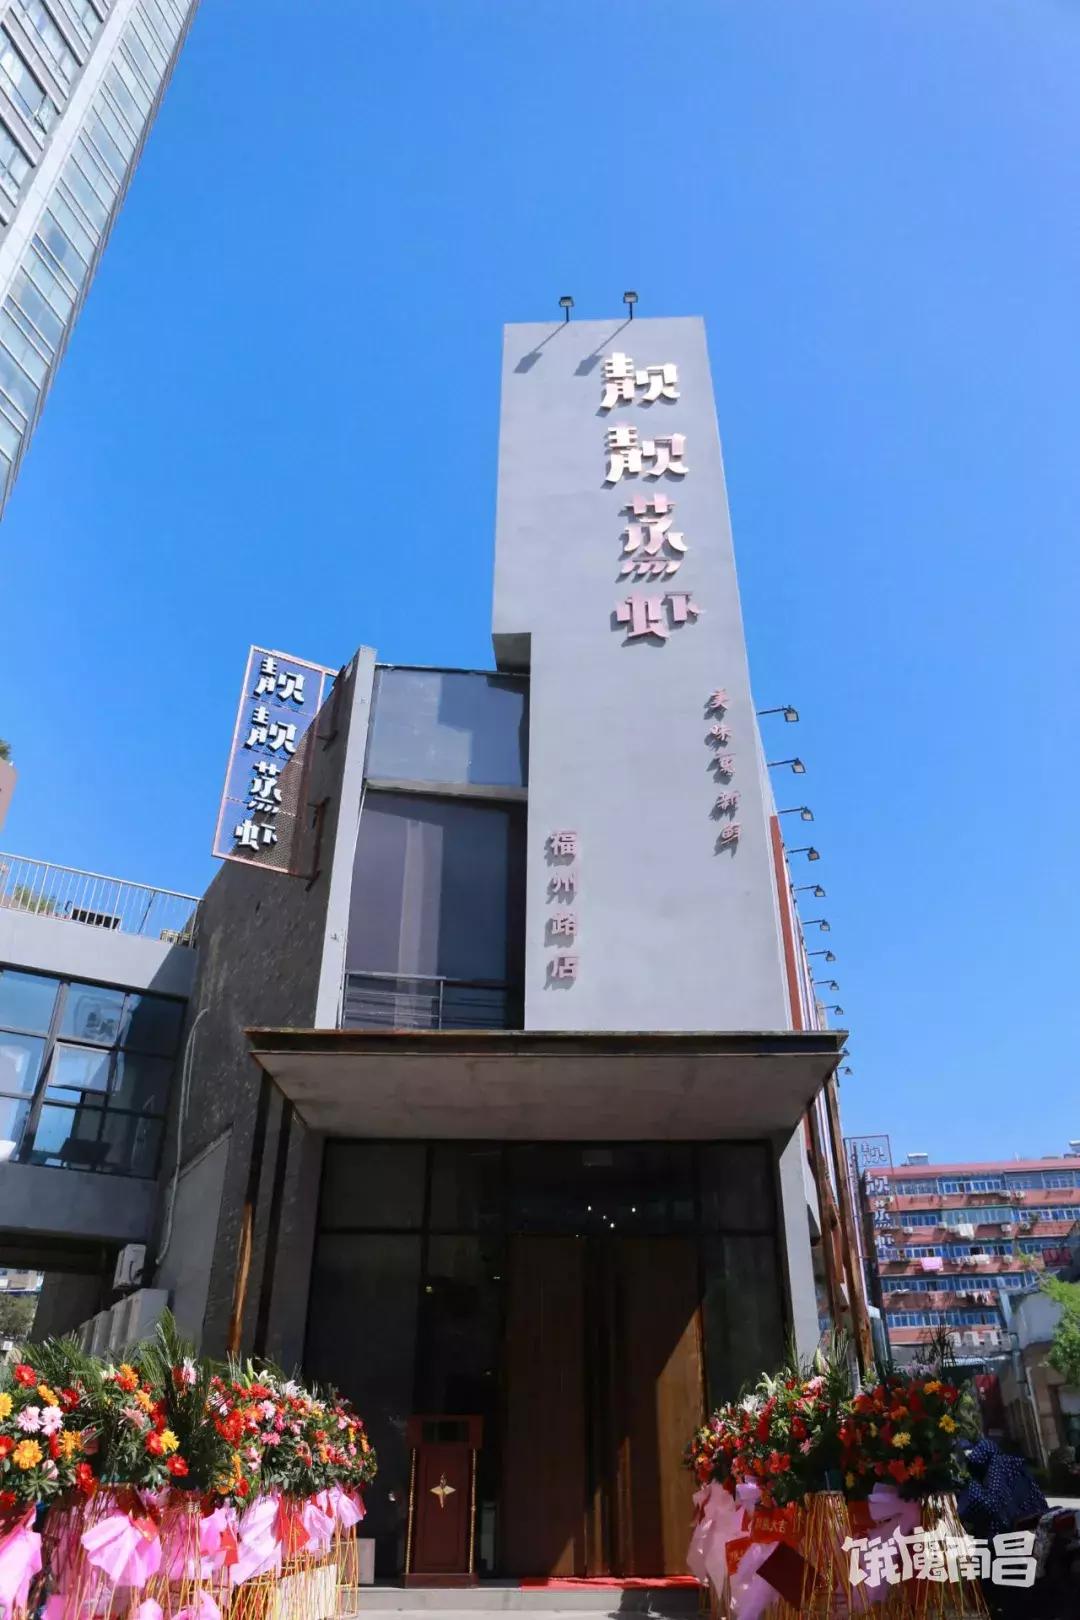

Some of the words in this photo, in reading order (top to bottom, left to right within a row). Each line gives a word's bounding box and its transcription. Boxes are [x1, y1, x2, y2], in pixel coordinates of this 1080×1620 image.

[600, 352, 704, 639] 靓靓蒸虾
[234, 657, 305, 851] 靓靓蒸虾
[550, 831, 579, 979] 福州路店
[861, 1141, 895, 1249] 靓靓蒸虾
